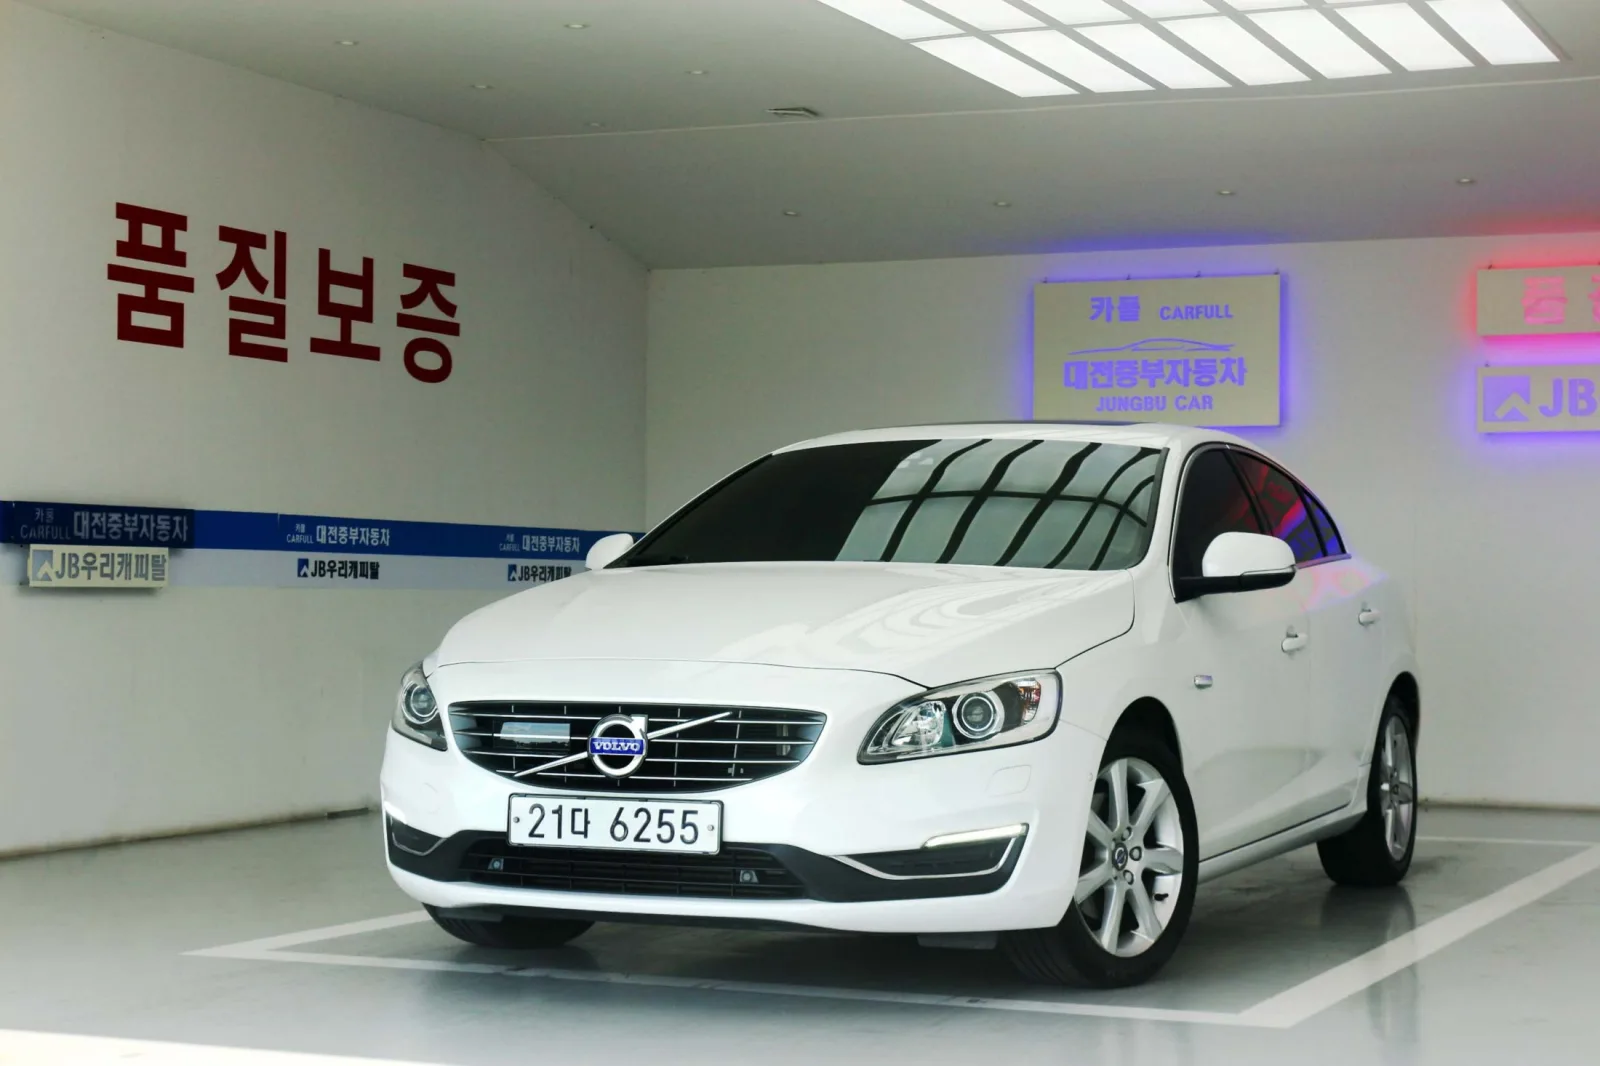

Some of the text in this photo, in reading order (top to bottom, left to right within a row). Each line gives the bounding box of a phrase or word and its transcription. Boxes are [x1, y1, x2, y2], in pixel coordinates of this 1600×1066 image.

[107, 202, 460, 383] 품질보증
[1159, 304, 1234, 321] CARFULL
[1064, 357, 1248, 390] 대전중부자동차
[1096, 394, 1213, 412] JUNGBU CAR
[1538, 377, 1600, 418] JB
[20, 525, 71, 540] CARFULL
[73, 511, 189, 542] 대전중부자동차
[316, 525, 390, 547] 대전중부자동차
[286, 533, 314, 544] CARFULL
[522, 535, 580, 553] 대전중부자동차
[55, 552, 167, 582] JB우리캐피탈
[310, 559, 380, 580] JB우리캐피탈
[593, 741, 641, 752] VOLVO
[528, 803, 700, 845] 21다 6255
